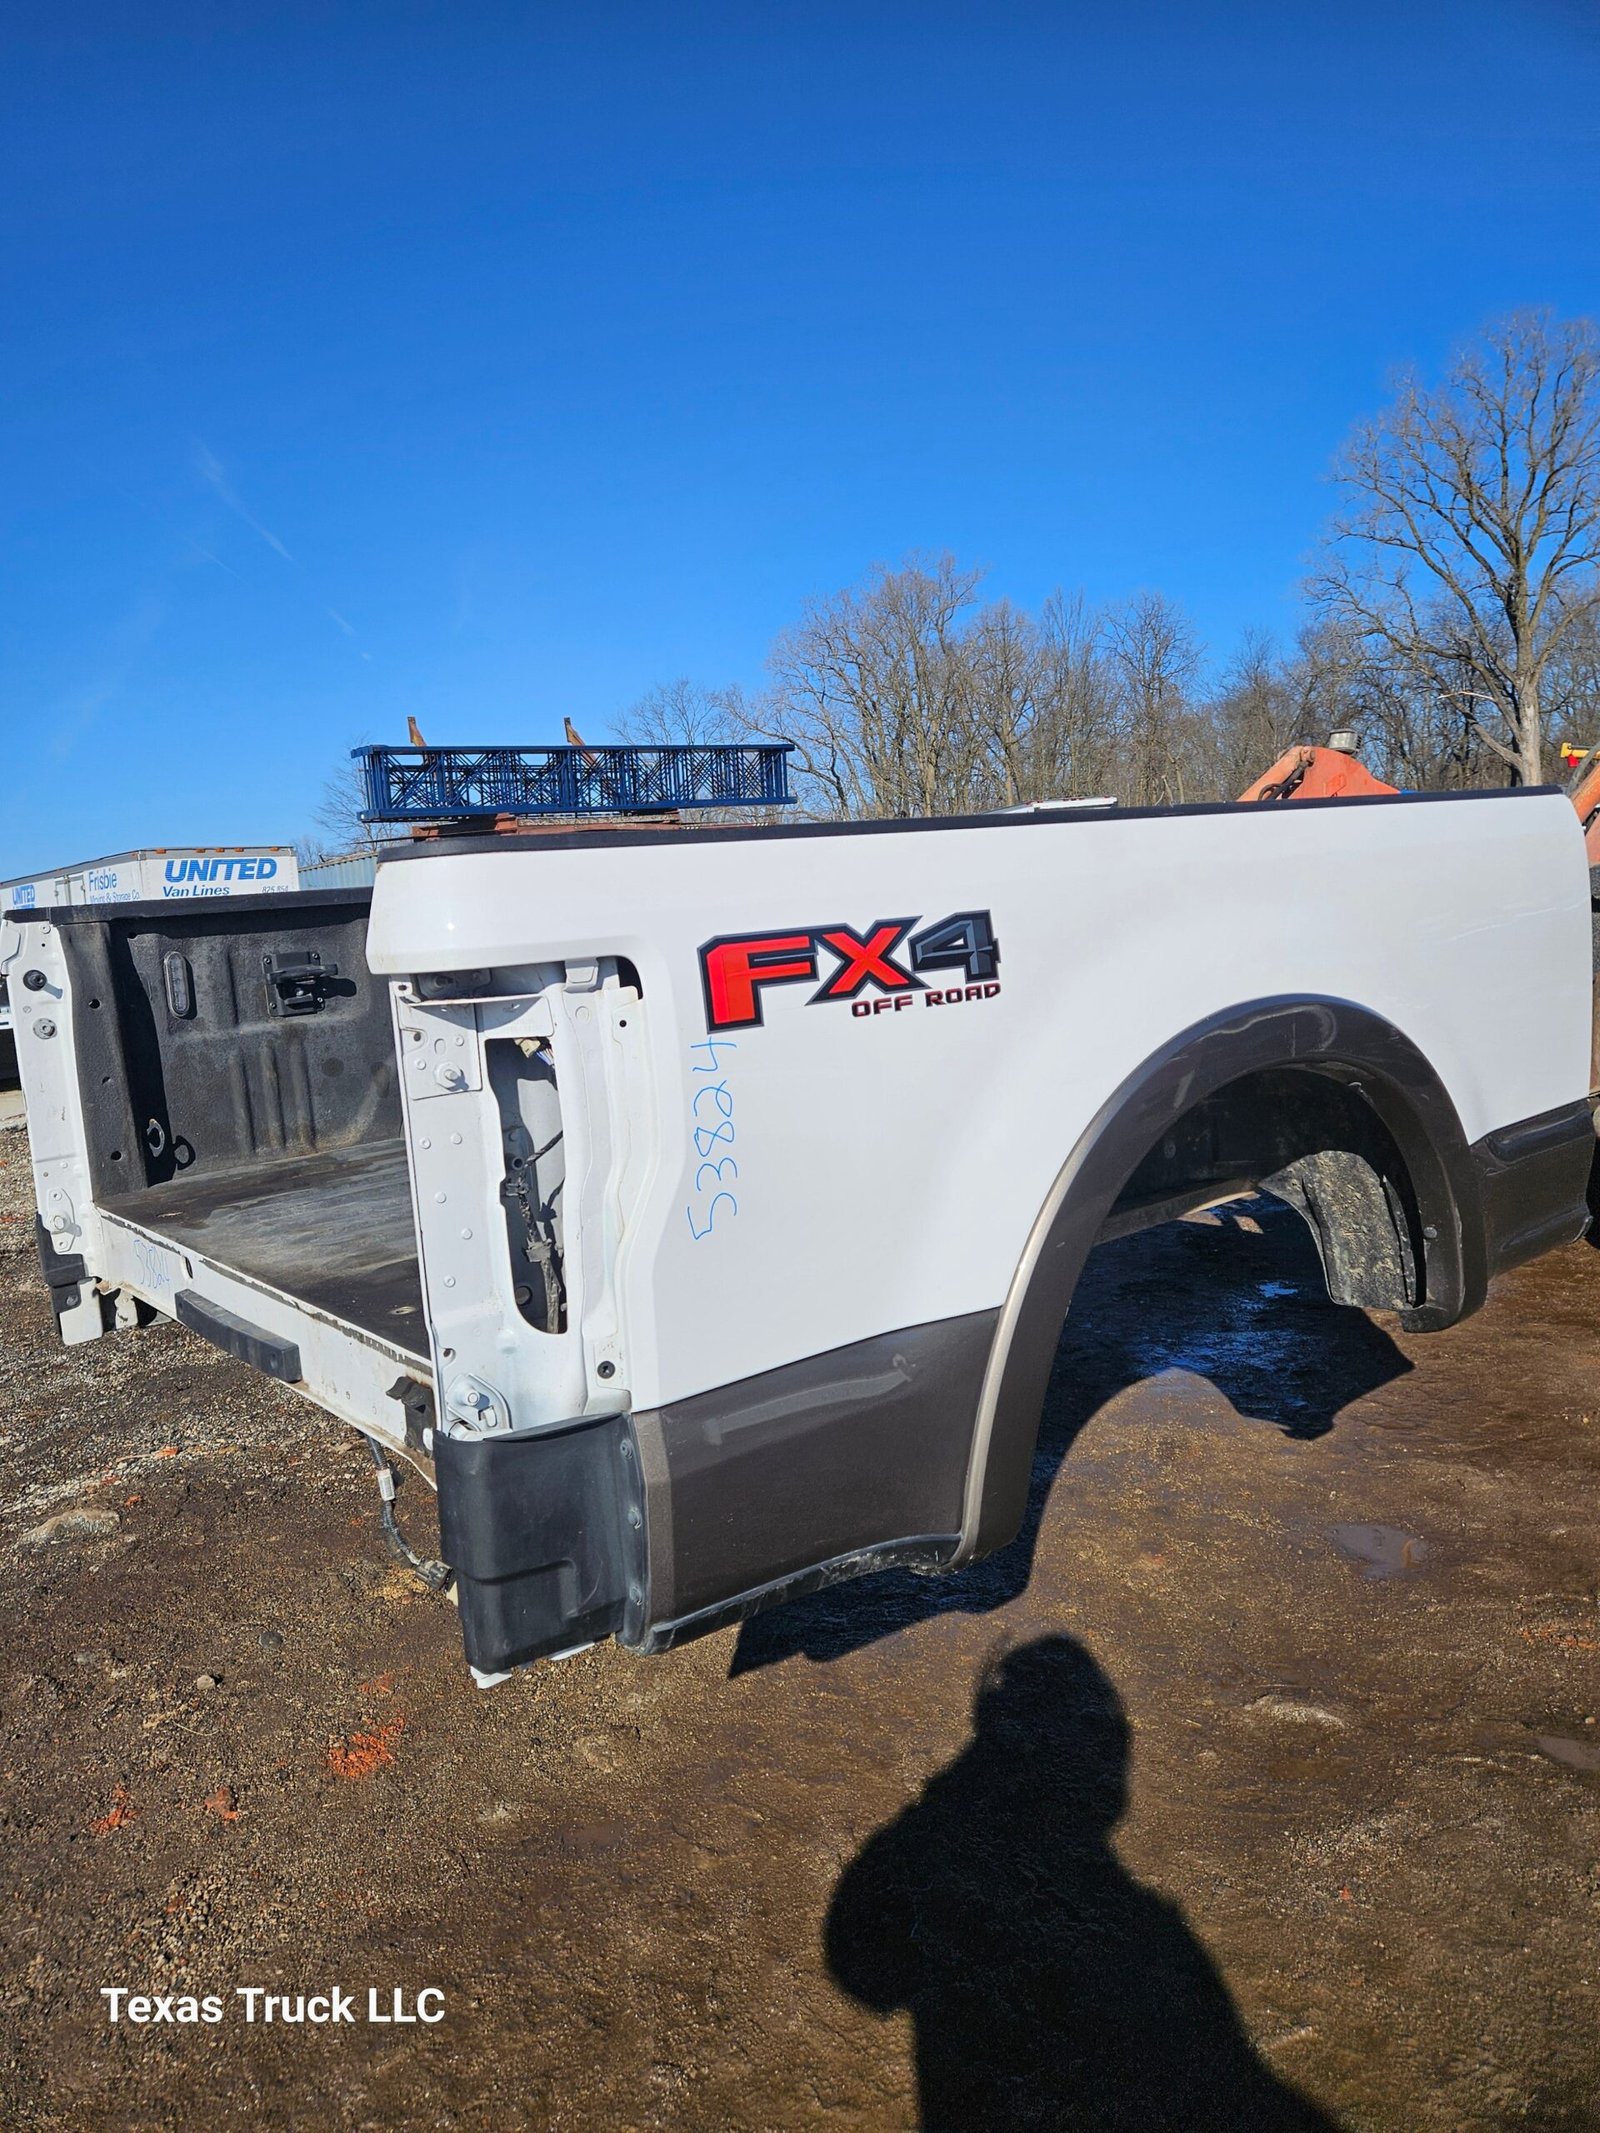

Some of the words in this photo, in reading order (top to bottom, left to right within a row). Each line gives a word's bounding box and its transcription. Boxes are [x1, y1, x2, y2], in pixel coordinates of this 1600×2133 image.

[89, 868, 117, 891] Frisbie
[165, 858, 277, 883] UNITED
[12, 885, 36, 905] UNITED
[162, 885, 190, 897] Van
[193, 884, 230, 896] Lines
[696, 909, 1002, 1034] FX4
[851, 994, 914, 1018] OFF
[925, 982, 1002, 1008] ROAD
[687, 1036, 738, 1240] 53824
